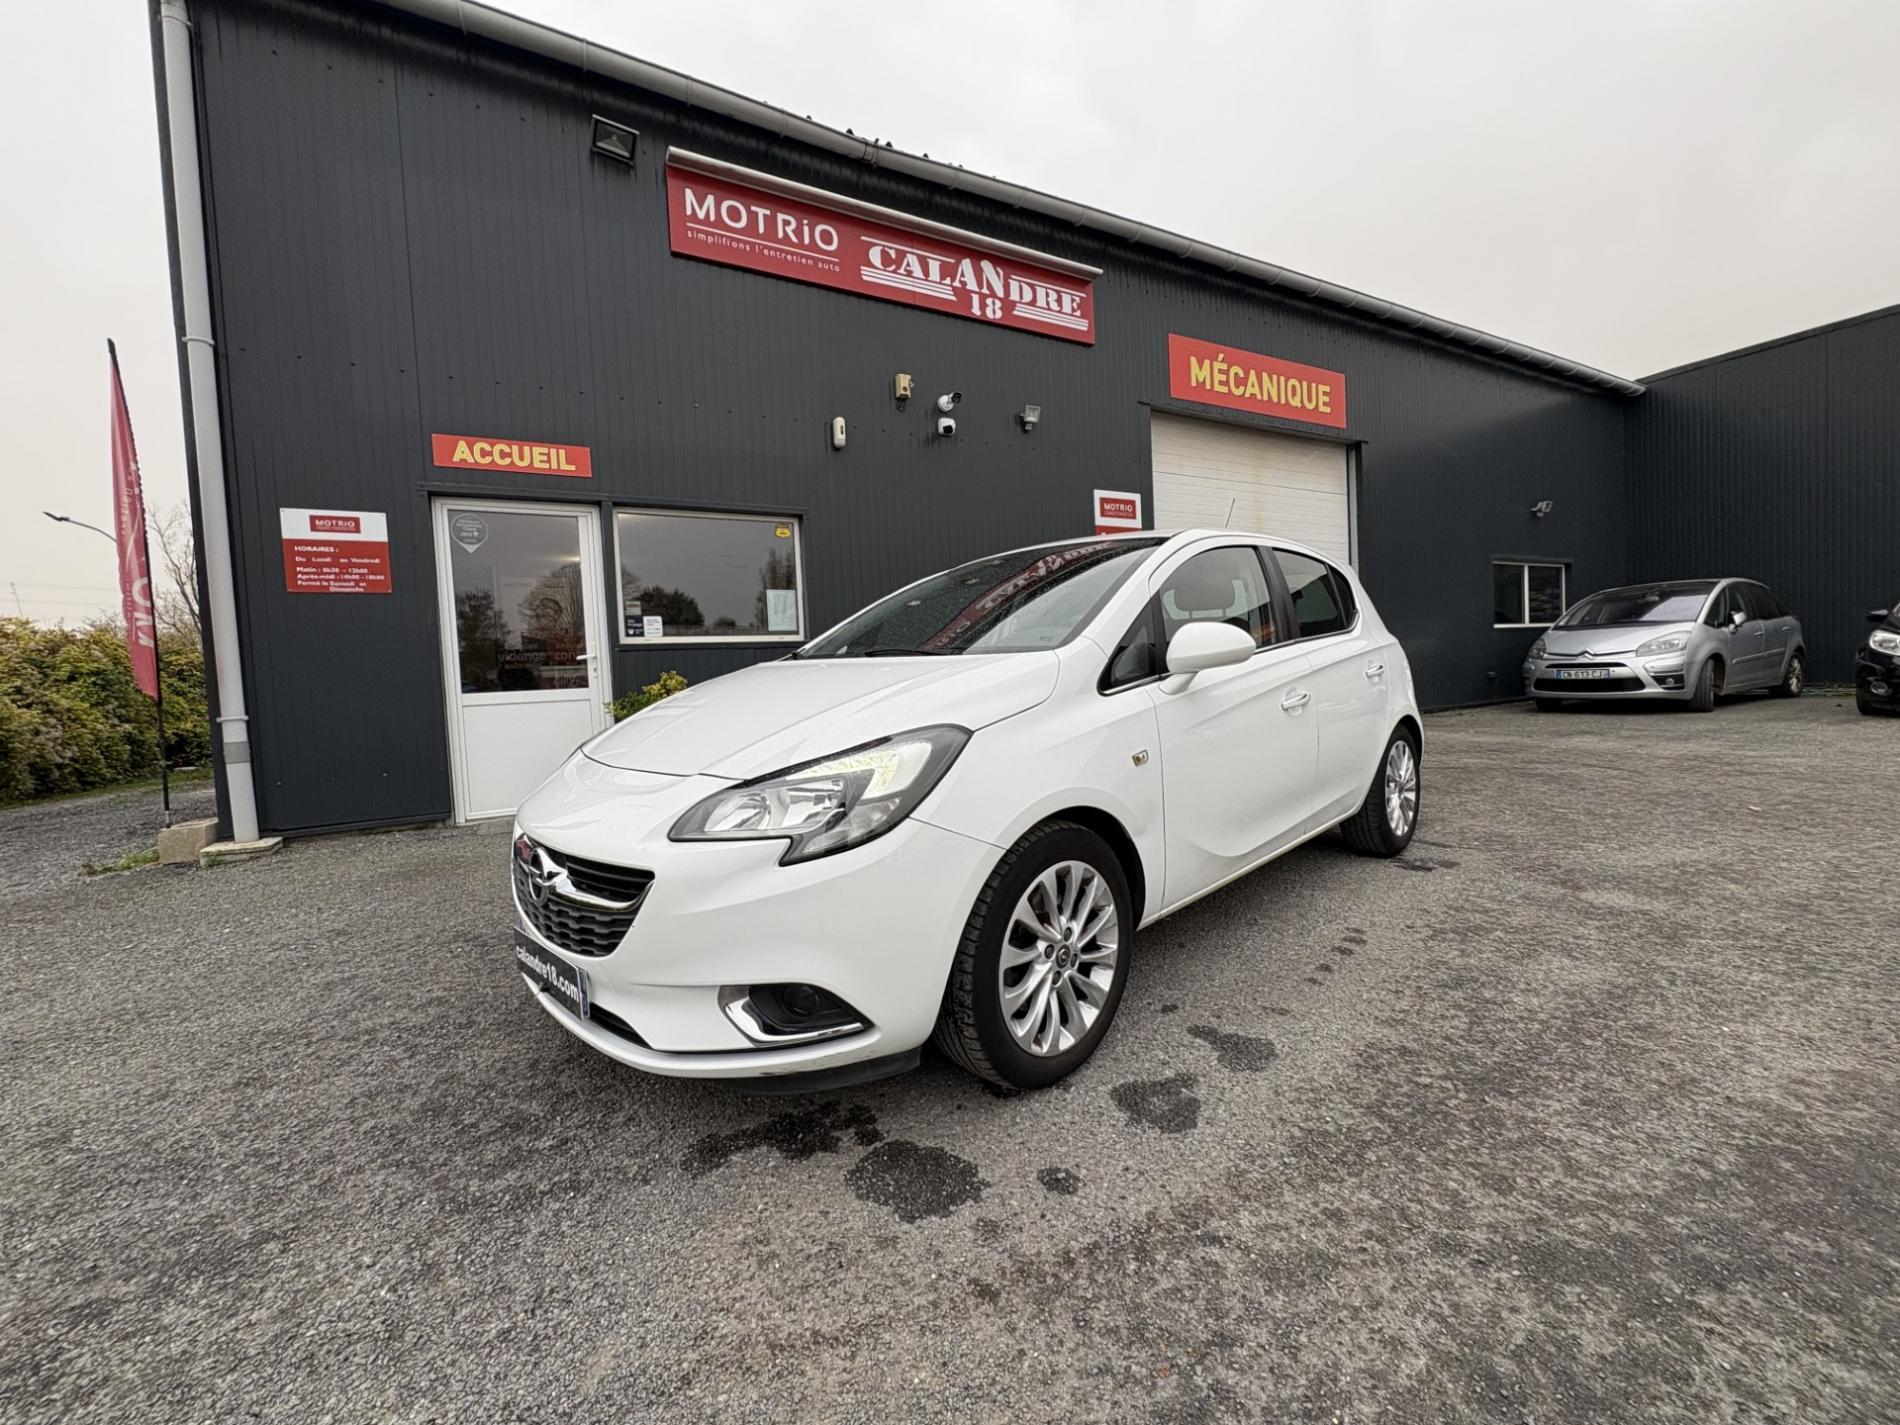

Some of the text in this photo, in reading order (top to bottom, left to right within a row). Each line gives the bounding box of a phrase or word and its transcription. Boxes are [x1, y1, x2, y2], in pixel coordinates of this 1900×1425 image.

[686, 229, 841, 273] simplifions l'entretien auto
[868, 244, 1082, 317] CALANDRE
[970, 292, 1003, 321] 18
[1189, 352, 1332, 414] MÉCANIQUE
[452, 440, 576, 471] ACCUEIL
